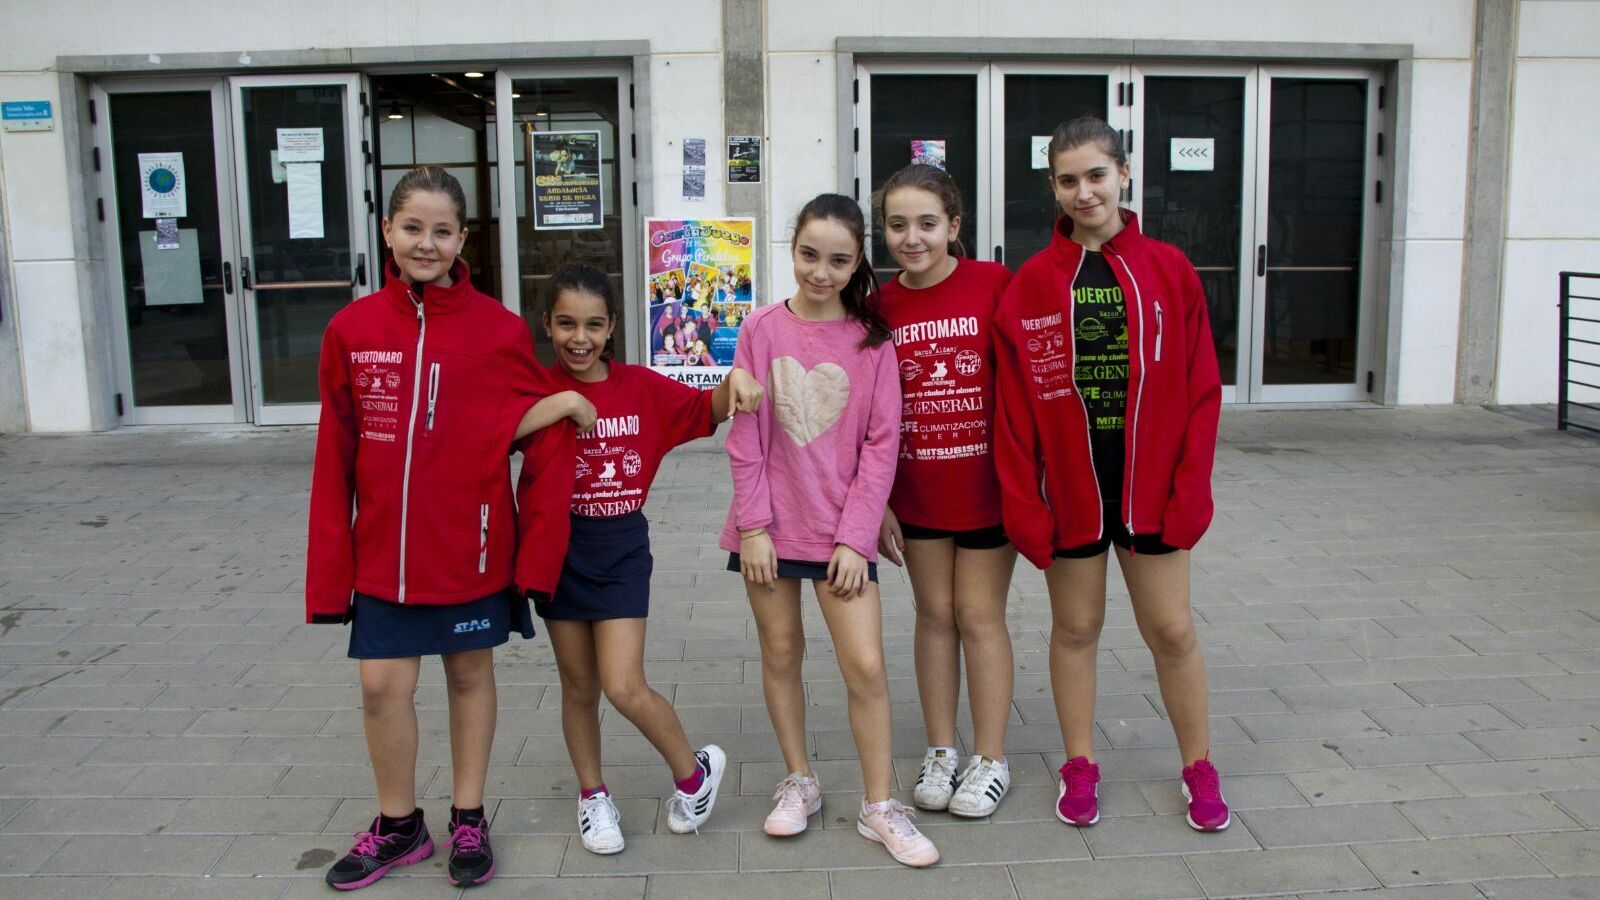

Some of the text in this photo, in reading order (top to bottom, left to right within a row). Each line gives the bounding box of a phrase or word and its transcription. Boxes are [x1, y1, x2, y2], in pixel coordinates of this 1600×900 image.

[351, 351, 403, 364] PUERTOMARO
[924, 389, 946, 398] ciudad
[914, 396, 984, 415] GENERALI
[919, 420, 987, 433] CLIMATIZACIÓN
[916, 442, 988, 456] MITSUBISHI
[578, 498, 642, 517] GENERALI
